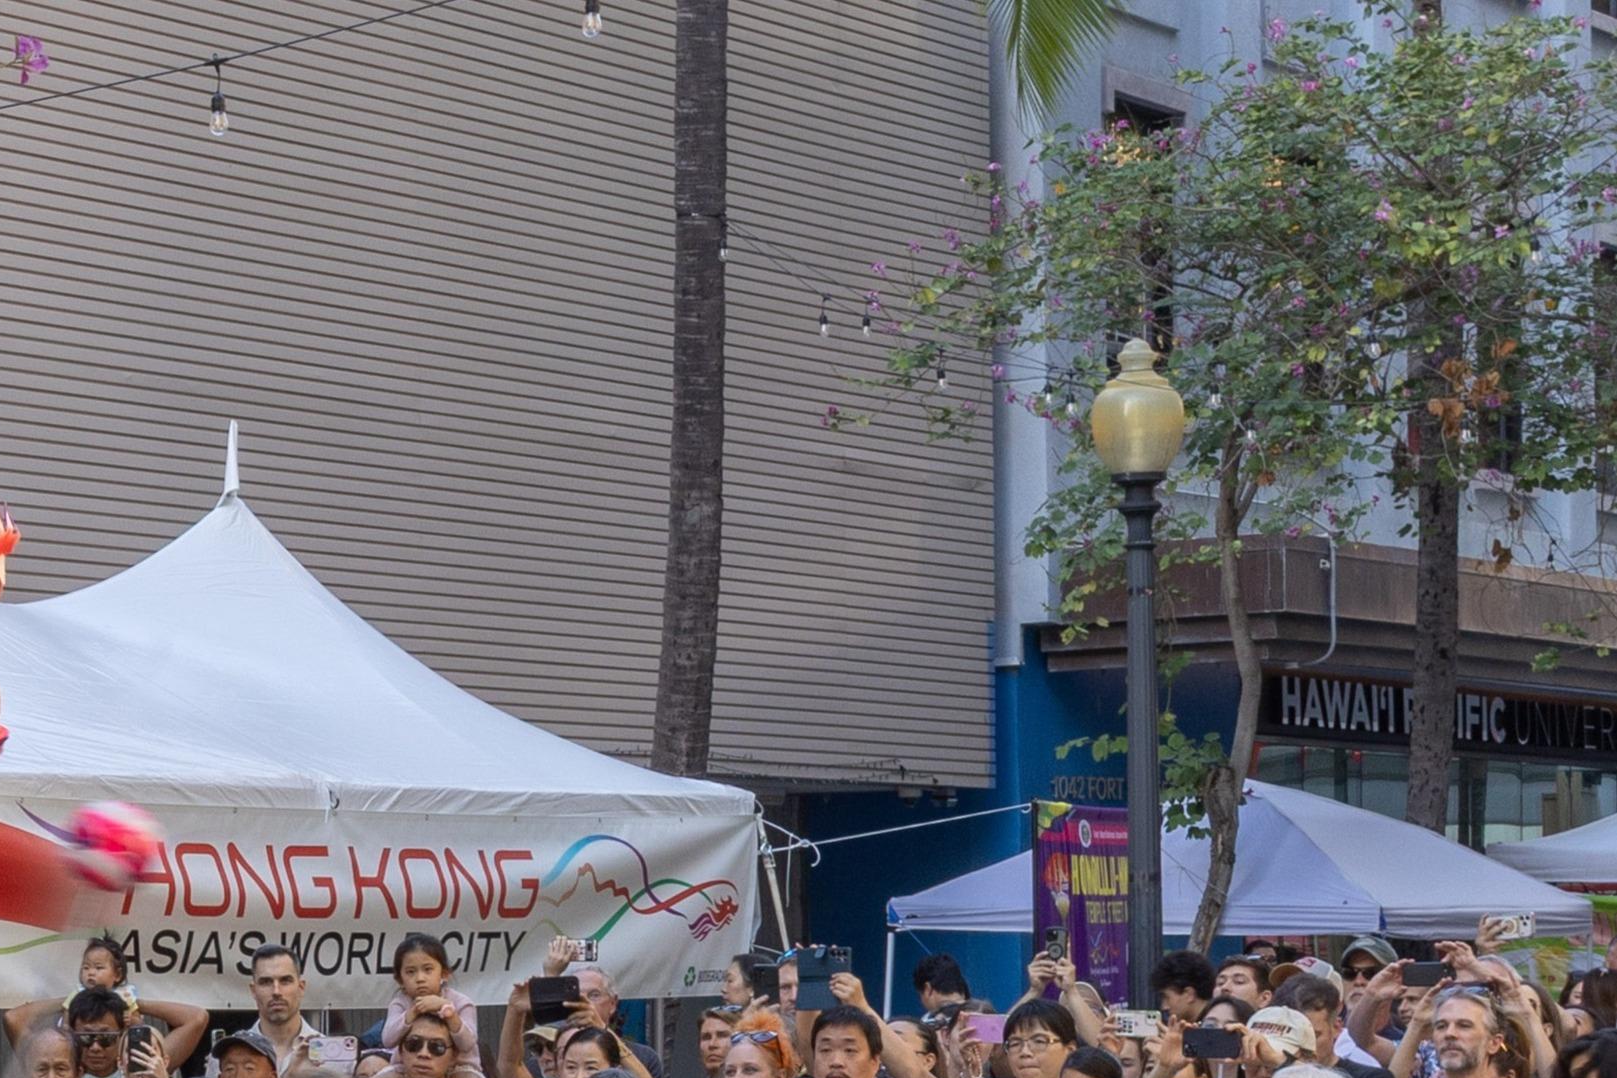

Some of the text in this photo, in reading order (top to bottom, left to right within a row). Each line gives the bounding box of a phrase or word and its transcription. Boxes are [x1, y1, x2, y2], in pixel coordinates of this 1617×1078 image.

[1050, 775, 1125, 801] 1042 FORT
[121, 841, 540, 920] HONG KONG
[280, 931, 419, 976] WORL
